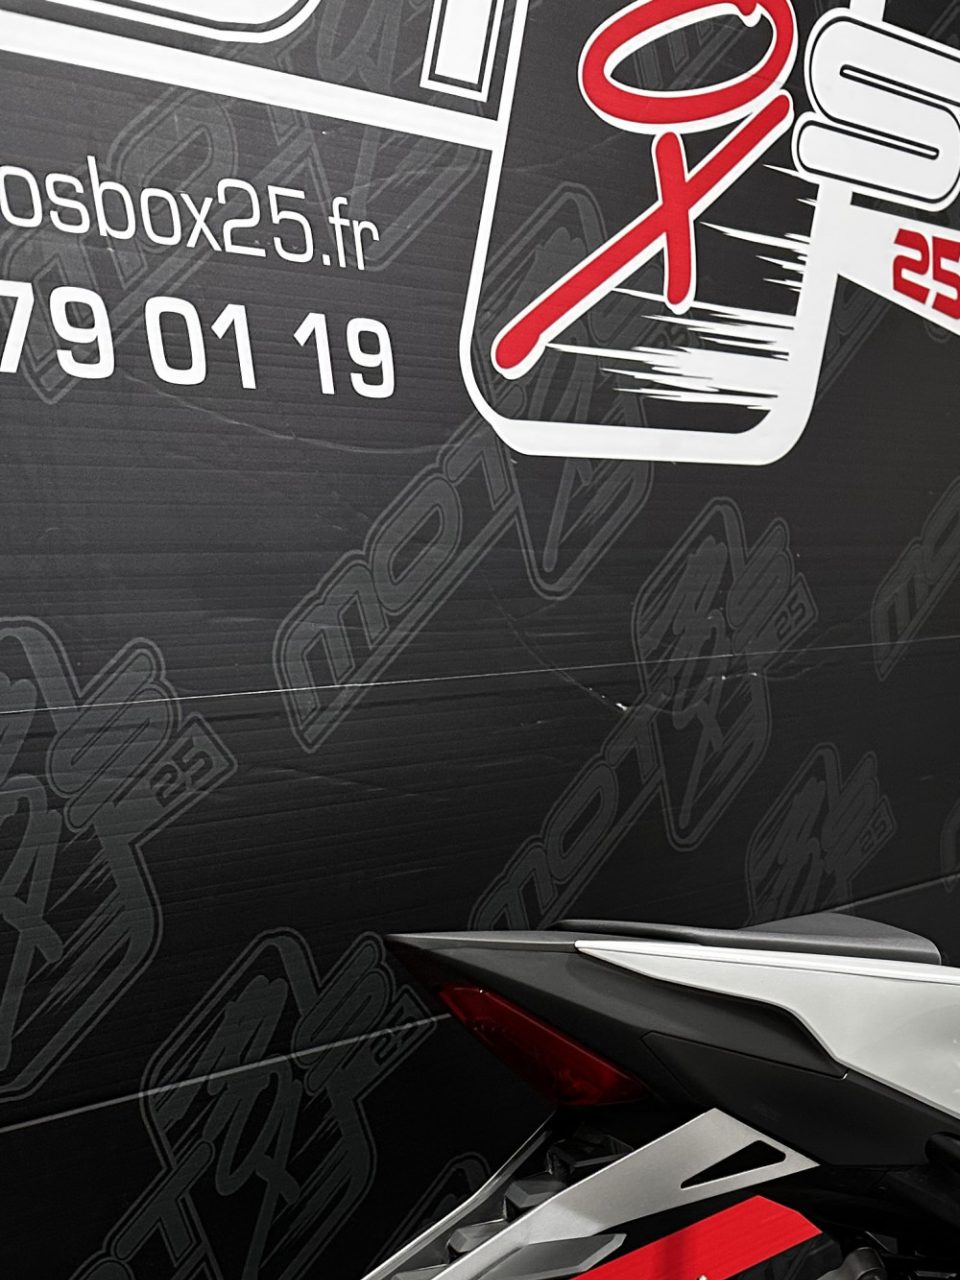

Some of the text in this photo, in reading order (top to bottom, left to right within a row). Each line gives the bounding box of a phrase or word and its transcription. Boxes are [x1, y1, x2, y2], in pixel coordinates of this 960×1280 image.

[0, 279, 395, 399] 79 01 19
